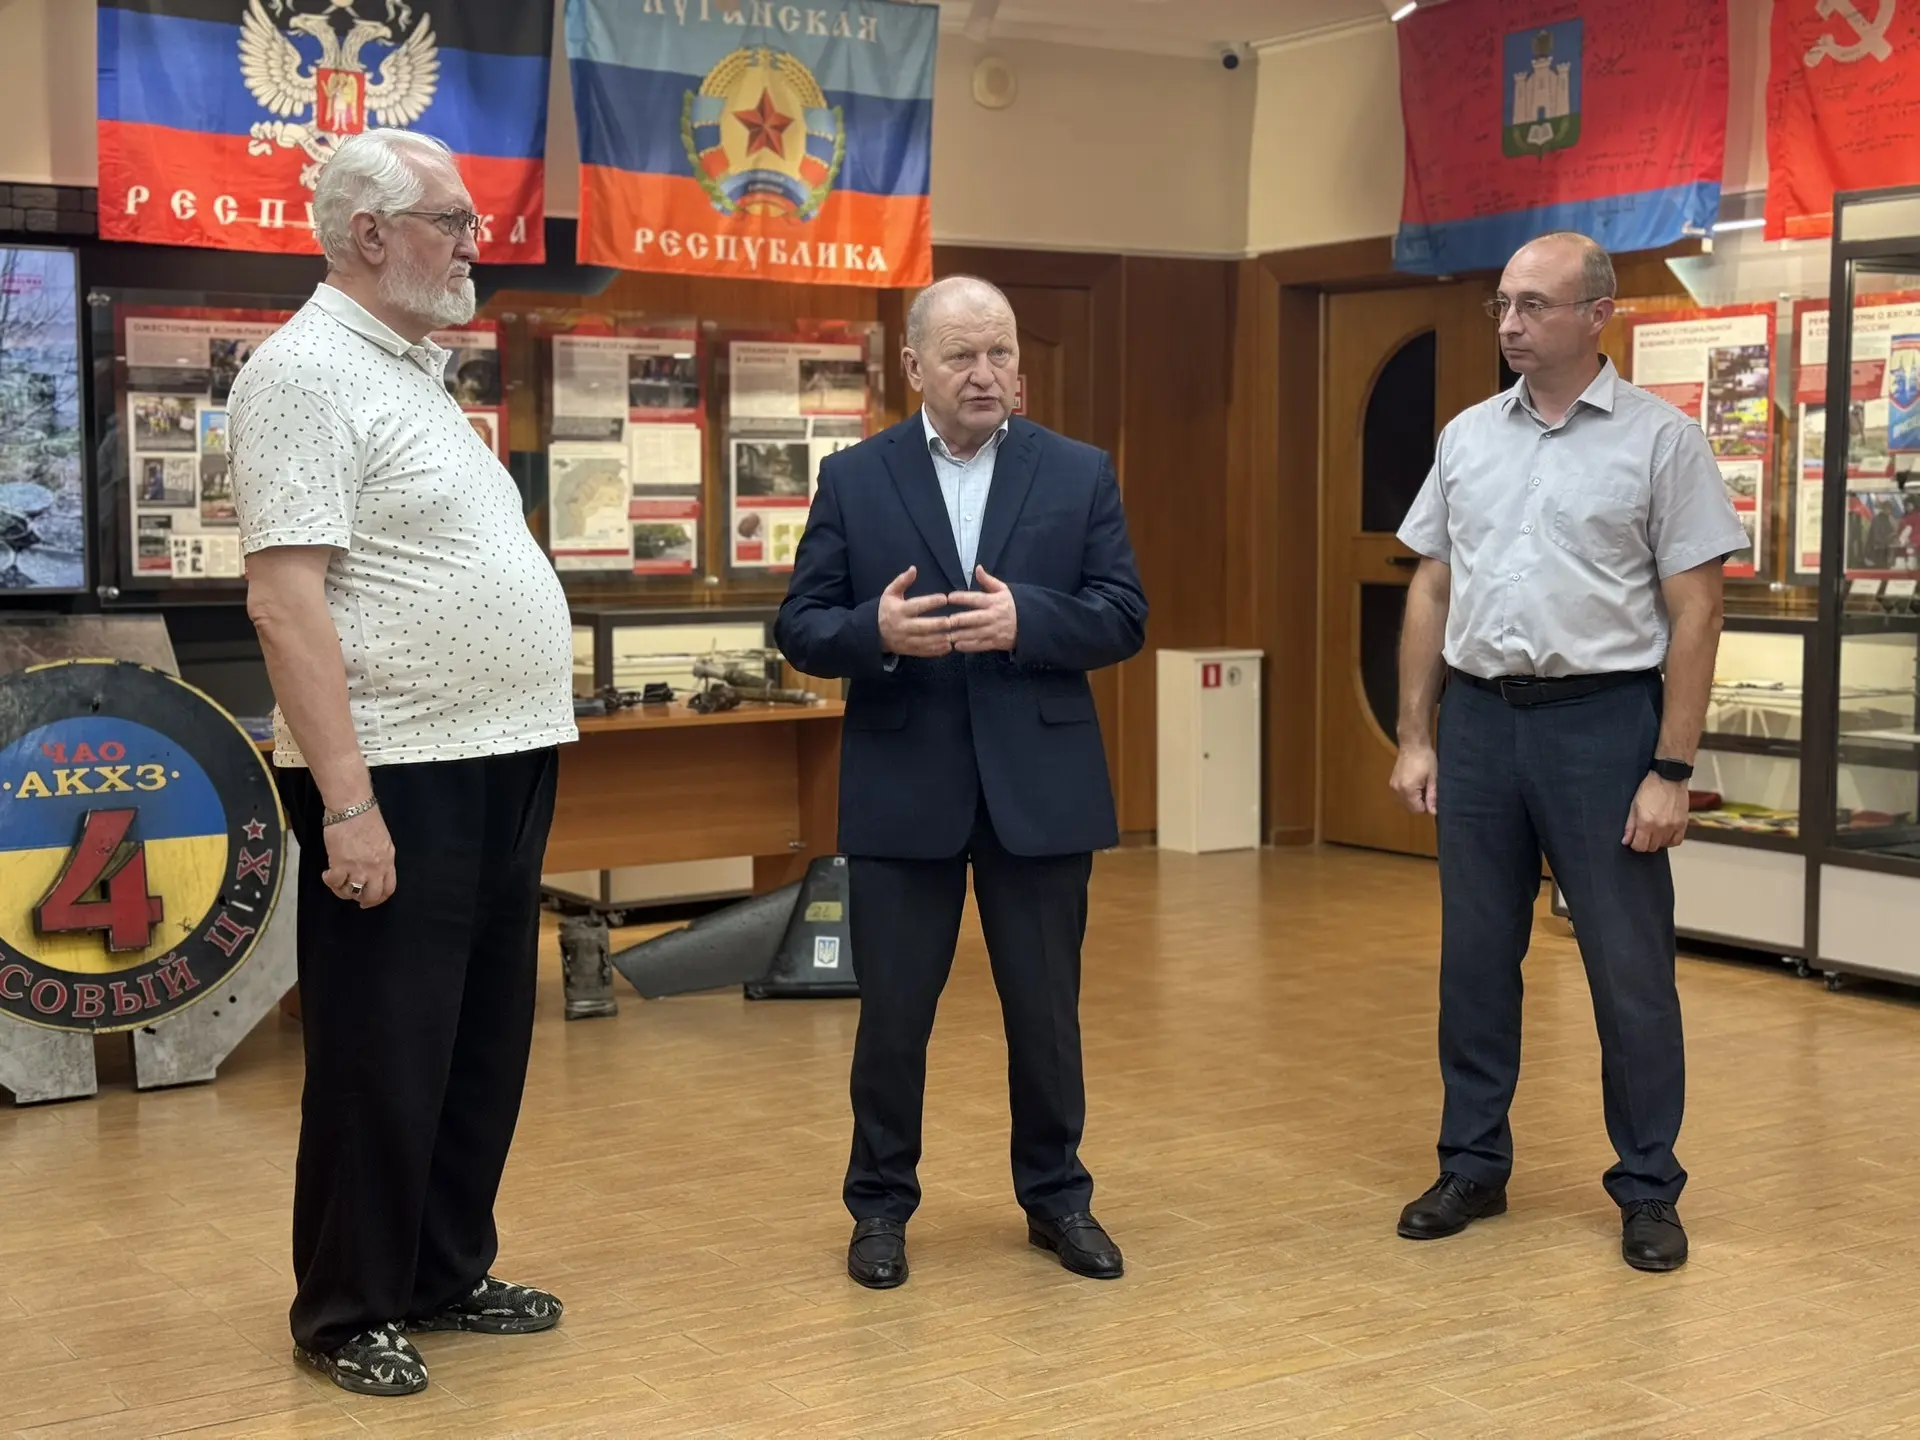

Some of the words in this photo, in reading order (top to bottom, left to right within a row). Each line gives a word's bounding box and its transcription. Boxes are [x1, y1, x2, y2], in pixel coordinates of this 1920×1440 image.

[633, 227, 888, 272] РЕСПУБЛИКА
[42, 740, 126, 763] ЧАО
[15, 763, 168, 799] АКХЗ
[33, 808, 164, 952] 4
[0, 951, 201, 1018] СОВЫЙ
[203, 847, 273, 957] ЦХ
